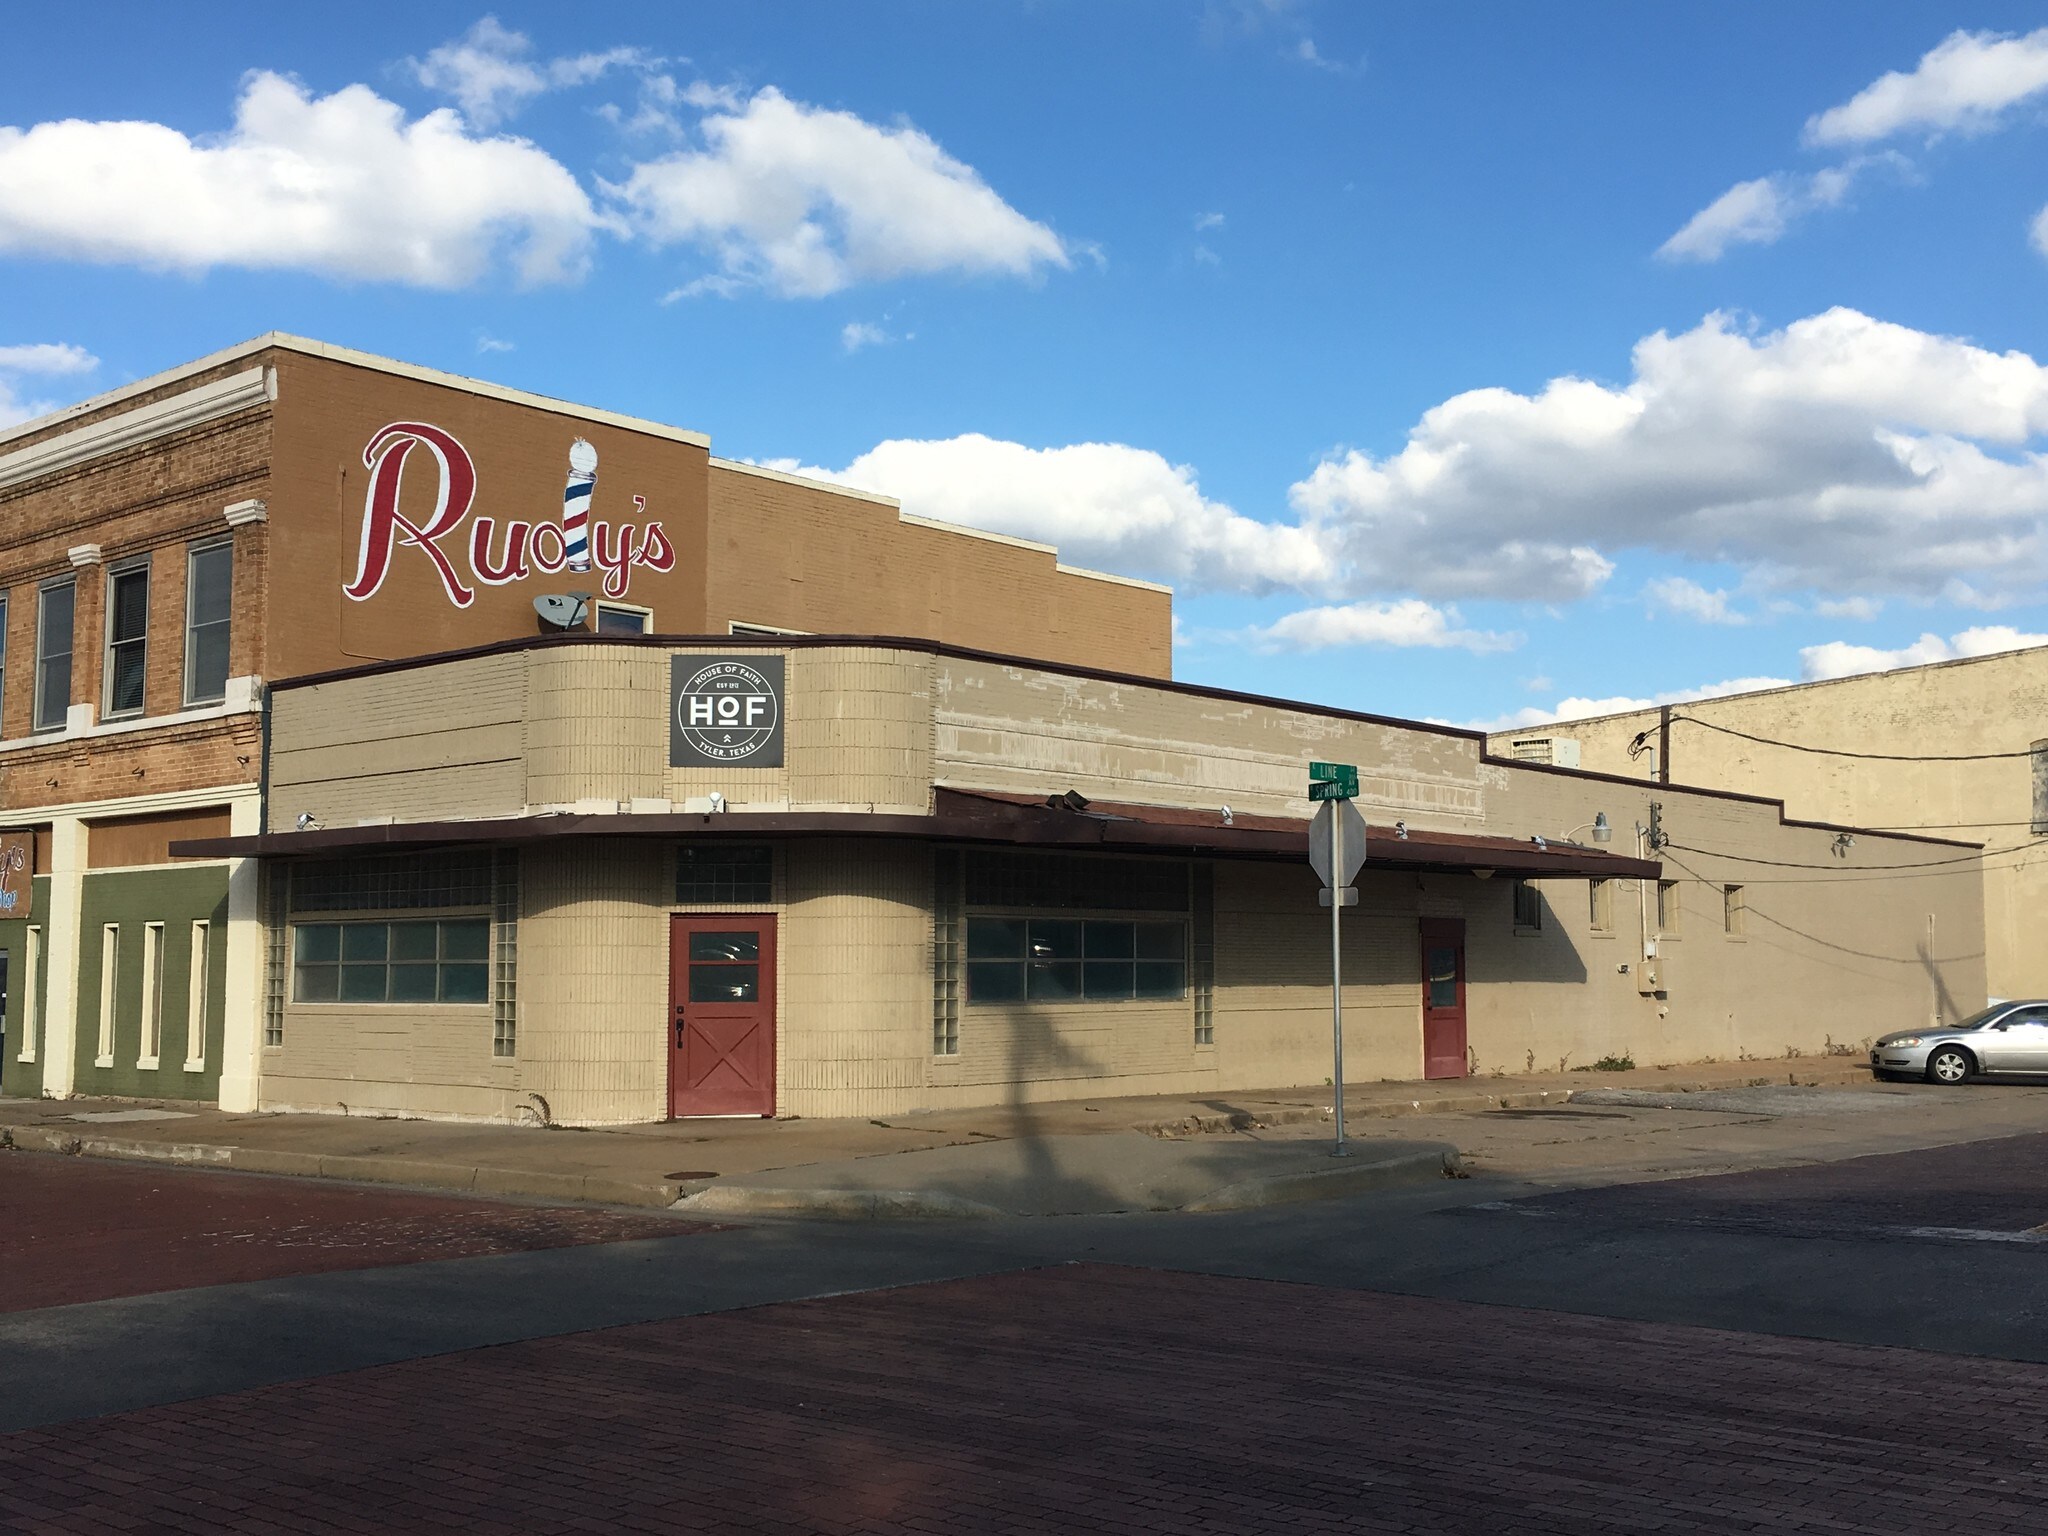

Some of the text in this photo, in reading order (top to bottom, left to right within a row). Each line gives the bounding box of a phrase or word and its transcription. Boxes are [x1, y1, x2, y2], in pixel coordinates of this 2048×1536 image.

[342, 421, 676, 609] Rudy's
[694, 665, 762, 686] HOUSE OF FAITH
[729, 742, 756, 757] TEXAS
[1320, 765, 1338, 779] LINE
[1315, 782, 1343, 799] SPRING
